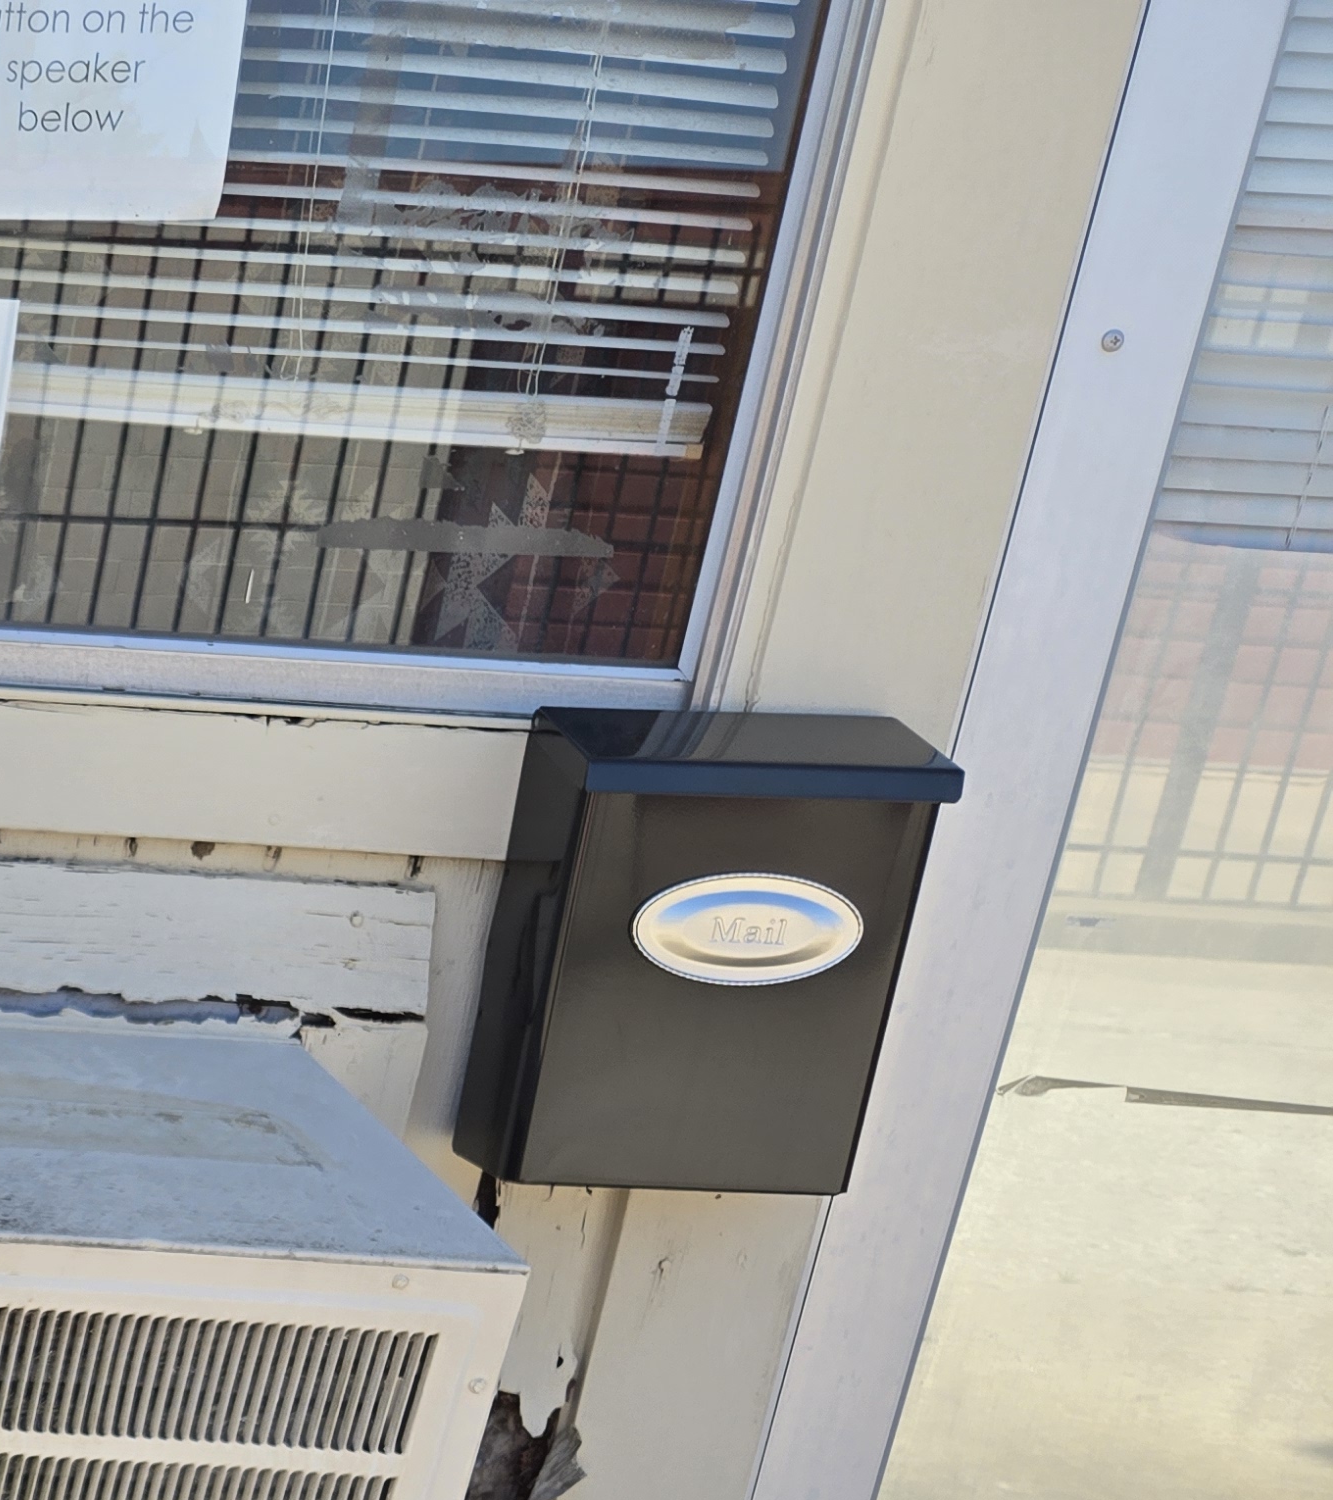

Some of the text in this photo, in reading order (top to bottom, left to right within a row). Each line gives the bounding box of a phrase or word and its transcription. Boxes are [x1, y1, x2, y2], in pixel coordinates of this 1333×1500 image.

[83, 9, 125, 34] on
[139, 2, 194, 34] the
[6, 52, 146, 90] speaker
[18, 101, 124, 132] below
[710, 915, 788, 945] Mail
